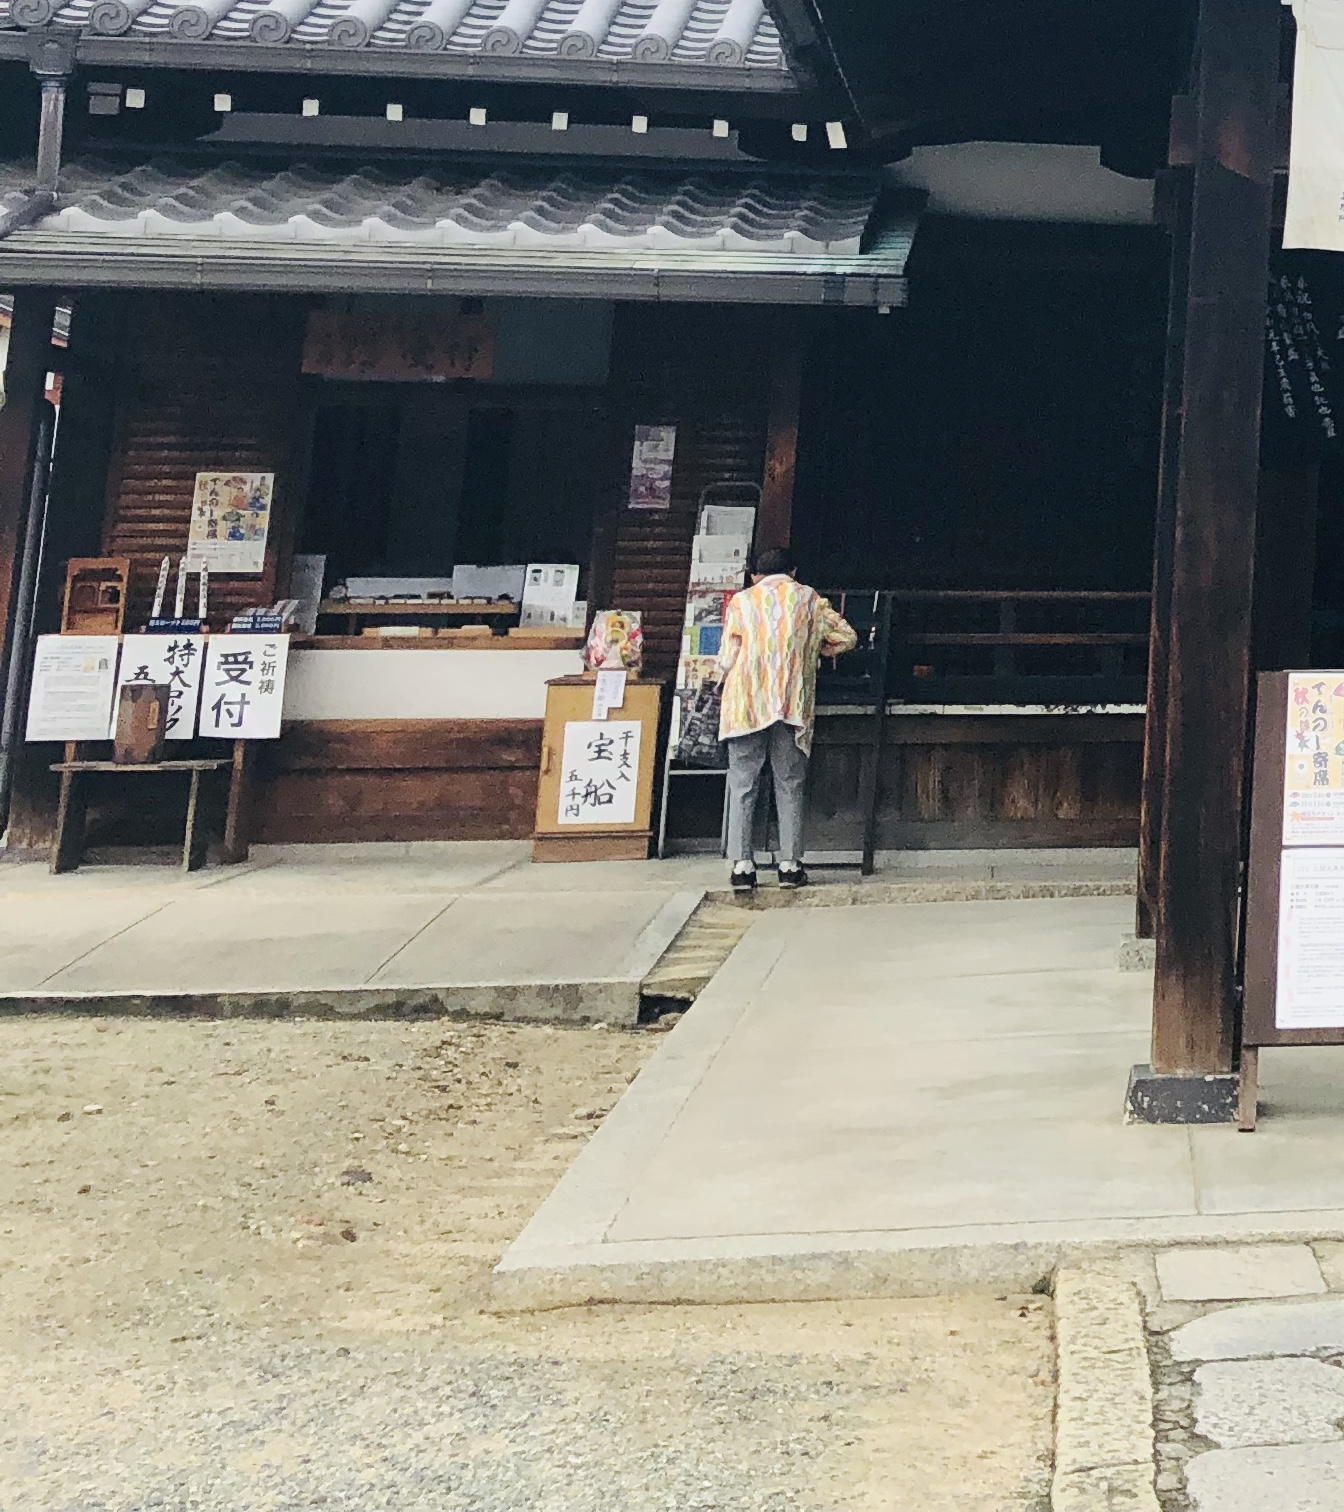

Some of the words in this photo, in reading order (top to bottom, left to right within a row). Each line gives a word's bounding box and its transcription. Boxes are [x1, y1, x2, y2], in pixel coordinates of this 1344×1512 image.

[211, 650, 254, 729] 受付
[564, 769, 583, 818] 五千円
[581, 732, 617, 807] 宝船
